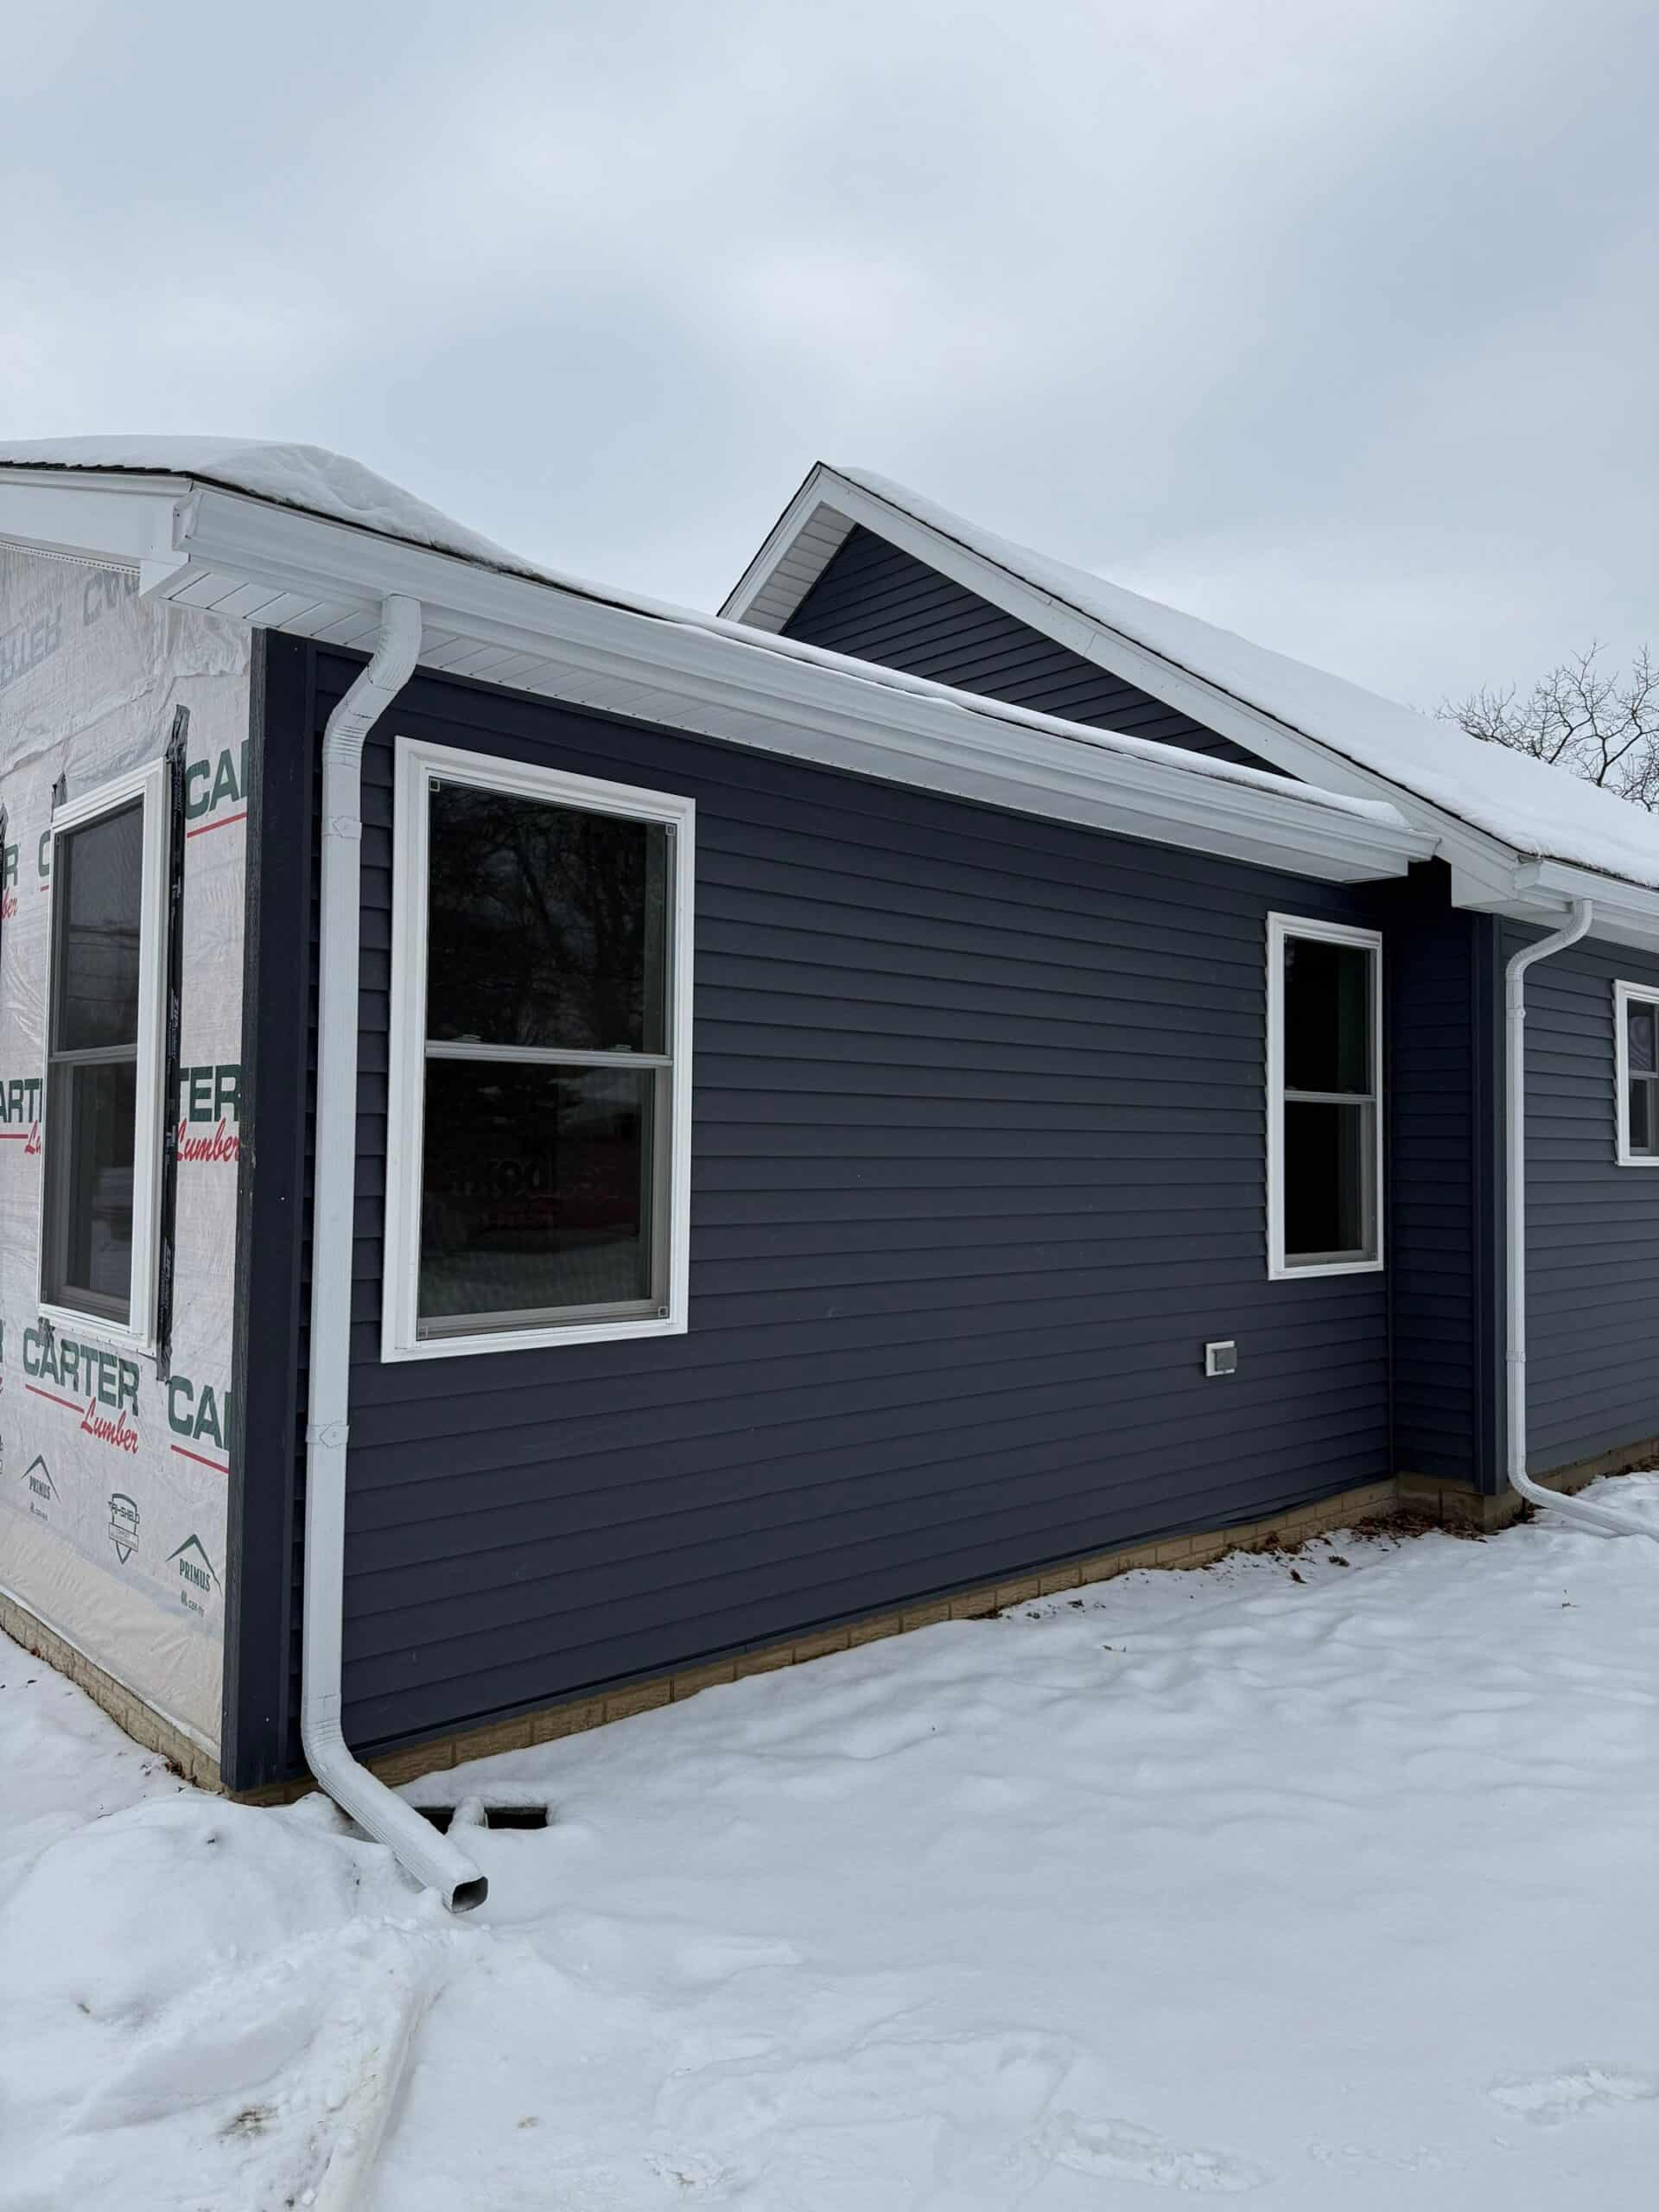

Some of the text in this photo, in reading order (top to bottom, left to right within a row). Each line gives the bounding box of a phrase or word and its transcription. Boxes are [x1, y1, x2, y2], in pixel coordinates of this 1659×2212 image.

[0, 1077, 42, 1123] ART
[179, 1064, 241, 1122] ER
[22, 1327, 140, 1417] CARTER
[80, 1395, 139, 1454] Lumber
[168, 1375, 232, 1452] CA
[179, 1557, 211, 1592] PRIMUS
